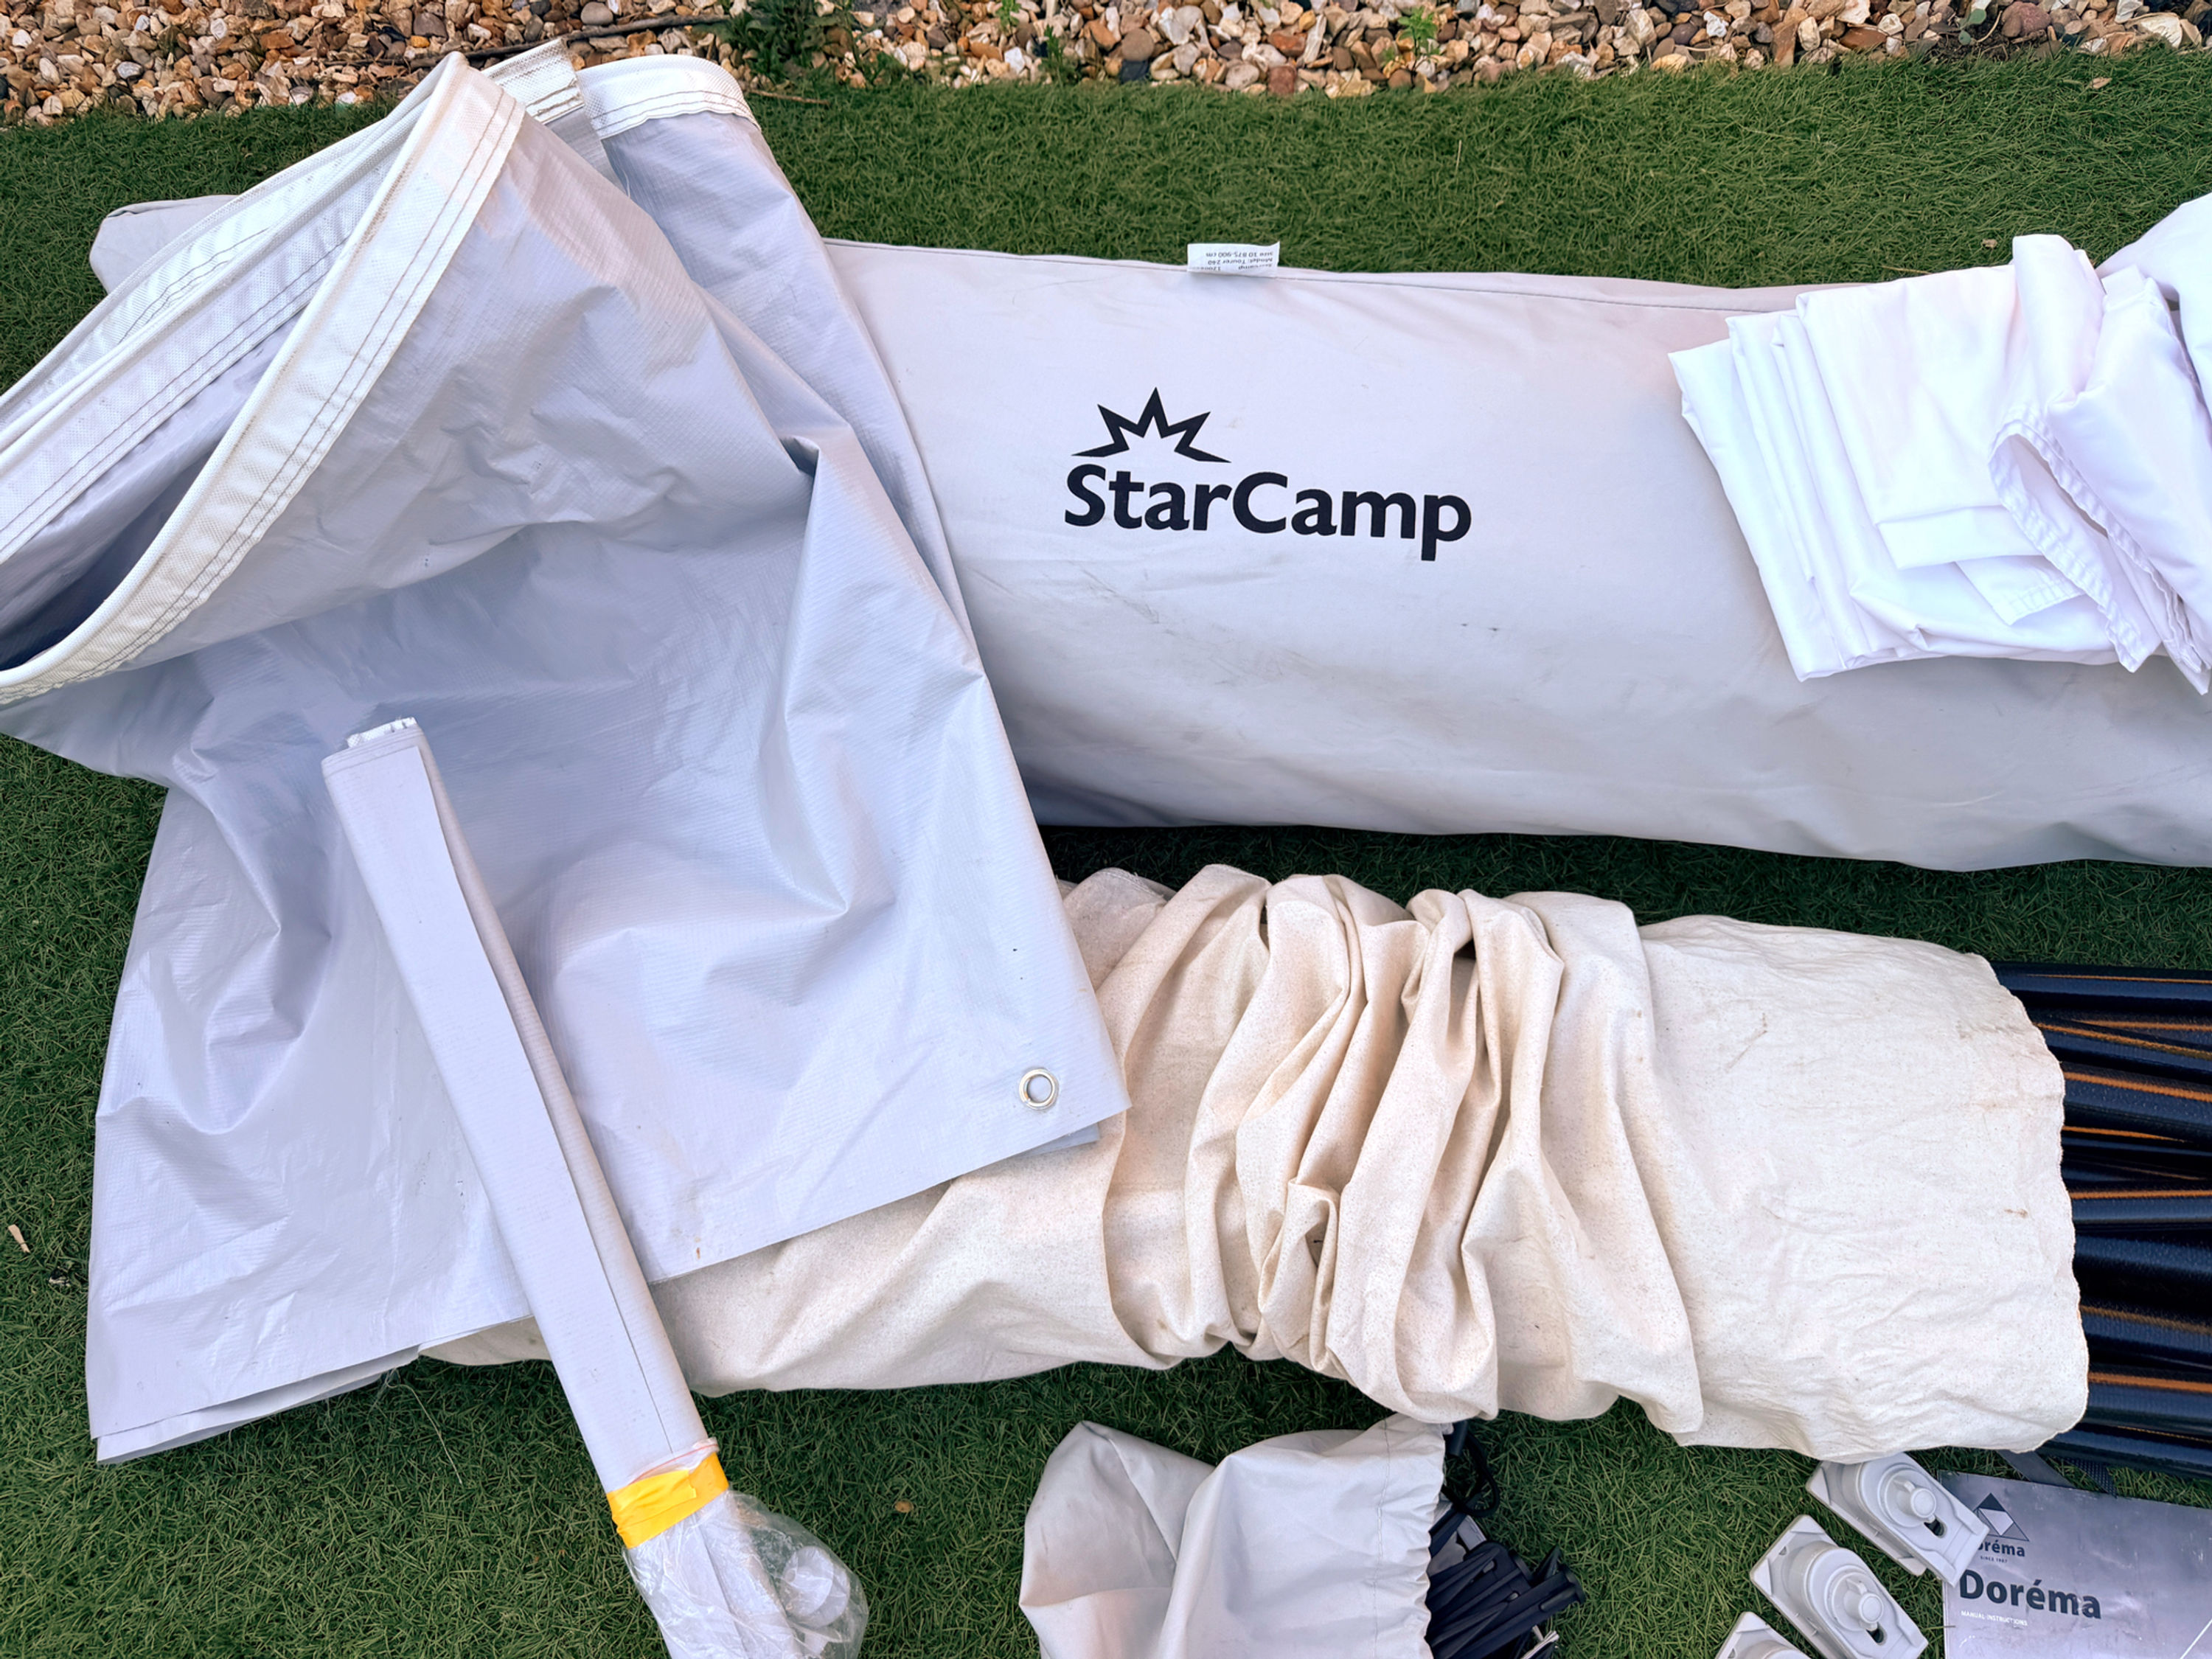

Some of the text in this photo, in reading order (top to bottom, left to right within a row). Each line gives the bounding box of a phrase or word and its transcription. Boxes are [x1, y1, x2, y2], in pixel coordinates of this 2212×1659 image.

[1065, 464, 1472, 561] StarCamp
[1960, 1569, 2101, 1618] Doréma
[1961, 1610, 2028, 1626] MANUAL INSTRUCTIONS
